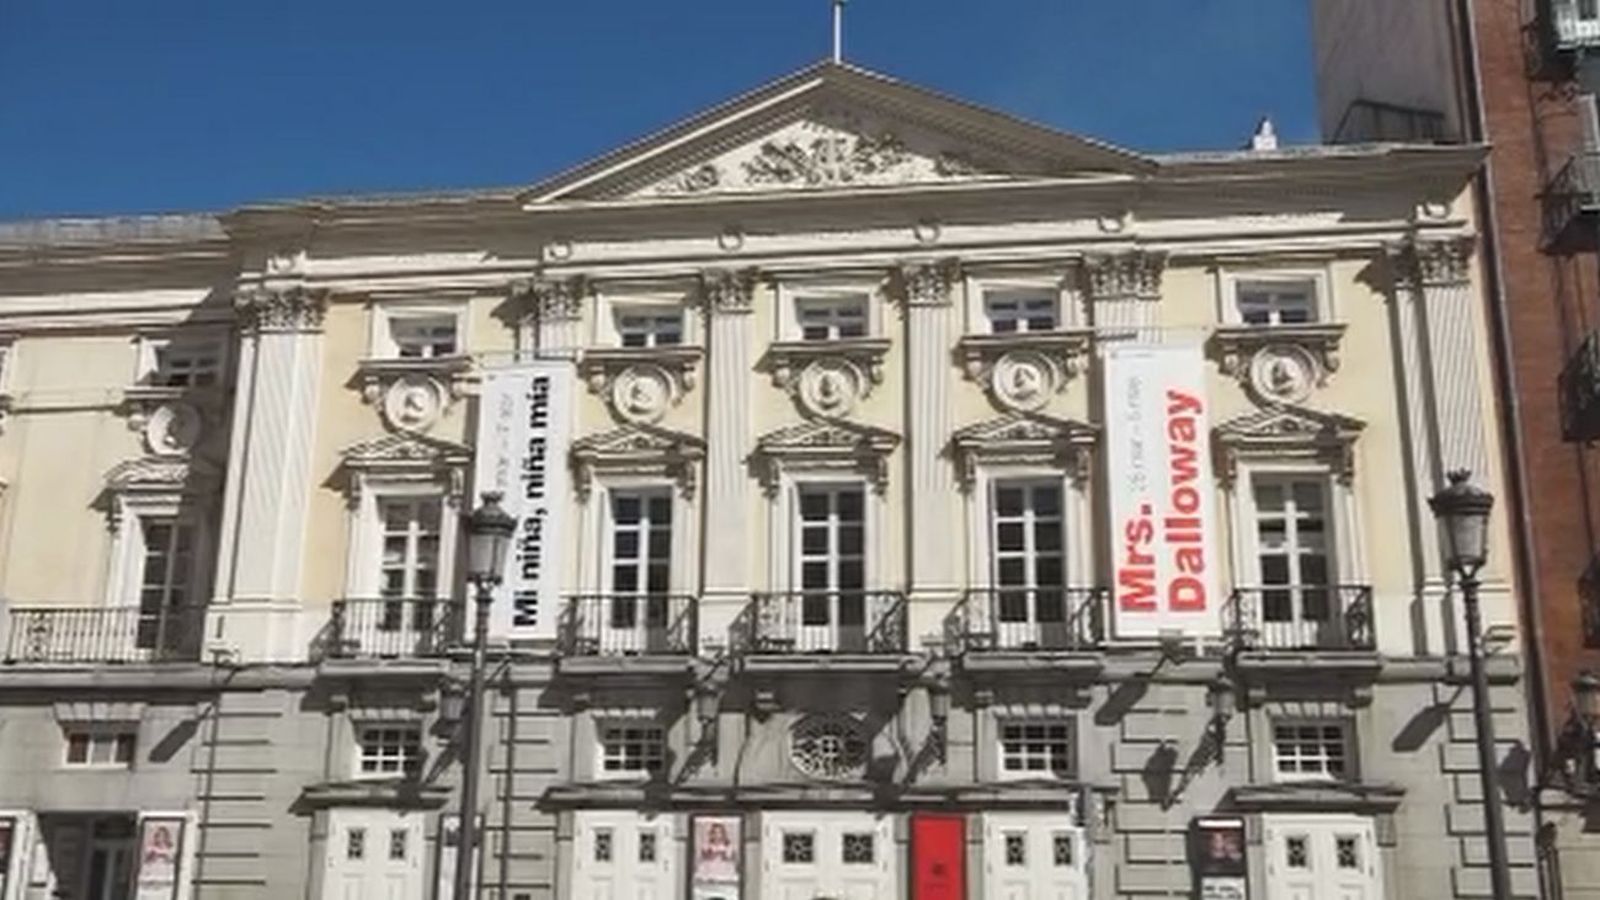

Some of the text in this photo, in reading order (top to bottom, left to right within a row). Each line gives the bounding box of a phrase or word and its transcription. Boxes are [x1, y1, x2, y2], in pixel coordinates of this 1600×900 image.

[513, 376, 549, 626] Mi niña, niña mía
[1116, 505, 1158, 611] Mrs.
[1163, 389, 1207, 612] Dalloway
